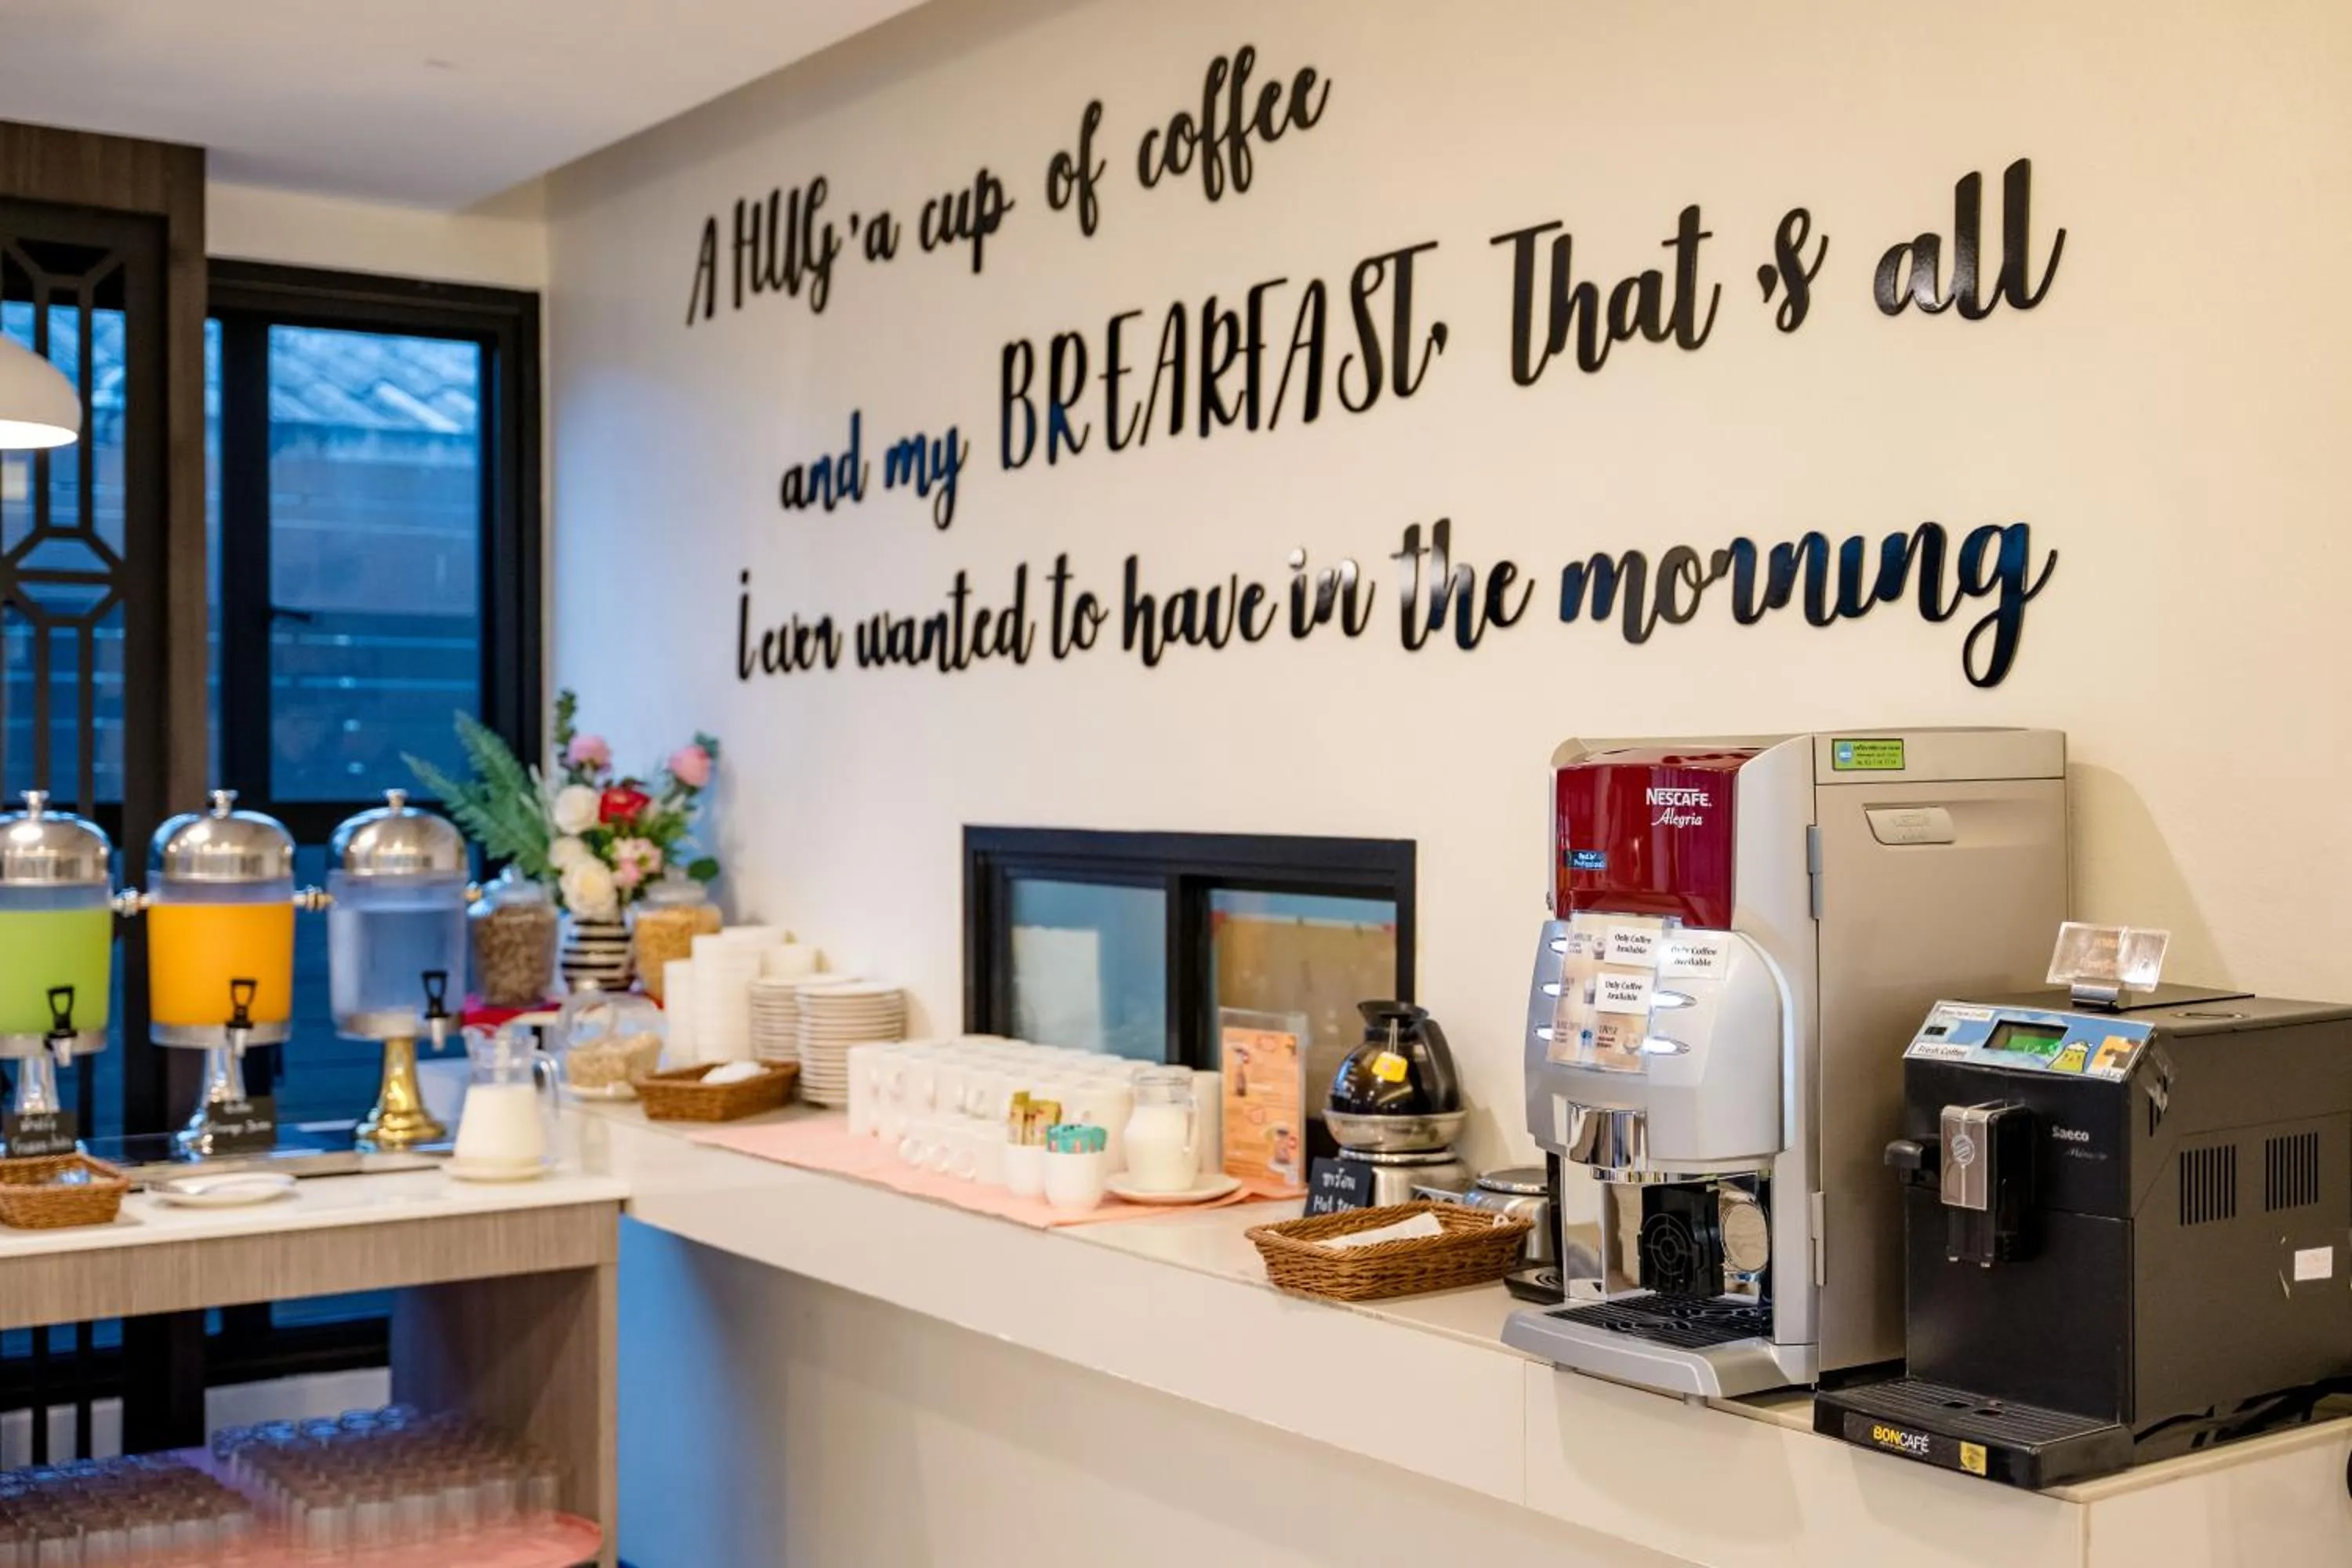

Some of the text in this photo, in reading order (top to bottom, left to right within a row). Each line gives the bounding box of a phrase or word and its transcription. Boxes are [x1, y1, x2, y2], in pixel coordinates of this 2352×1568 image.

[687, 216, 717, 326] A
[919, 168, 1015, 274] cup
[1047, 100, 1106, 238] of
[1138, 45, 1330, 202] coffee
[780, 409, 868, 513] and
[884, 426, 968, 531] my
[1874, 158, 2067, 321] all
[760, 614, 843, 675] ever
[856, 562, 1036, 674] wanted
[1046, 553, 1109, 660] to
[1123, 554, 1278, 668] have
[1288, 546, 1375, 639] in
[1389, 517, 1534, 652] the
[1559, 521, 2058, 688] morning
[1651, 808, 1702, 829] Alegria
[1690, 946, 1718, 956] Coffee
[2052, 1124, 2089, 1142] Saeco
[1872, 1425, 1929, 1454] BONCAFÉ
